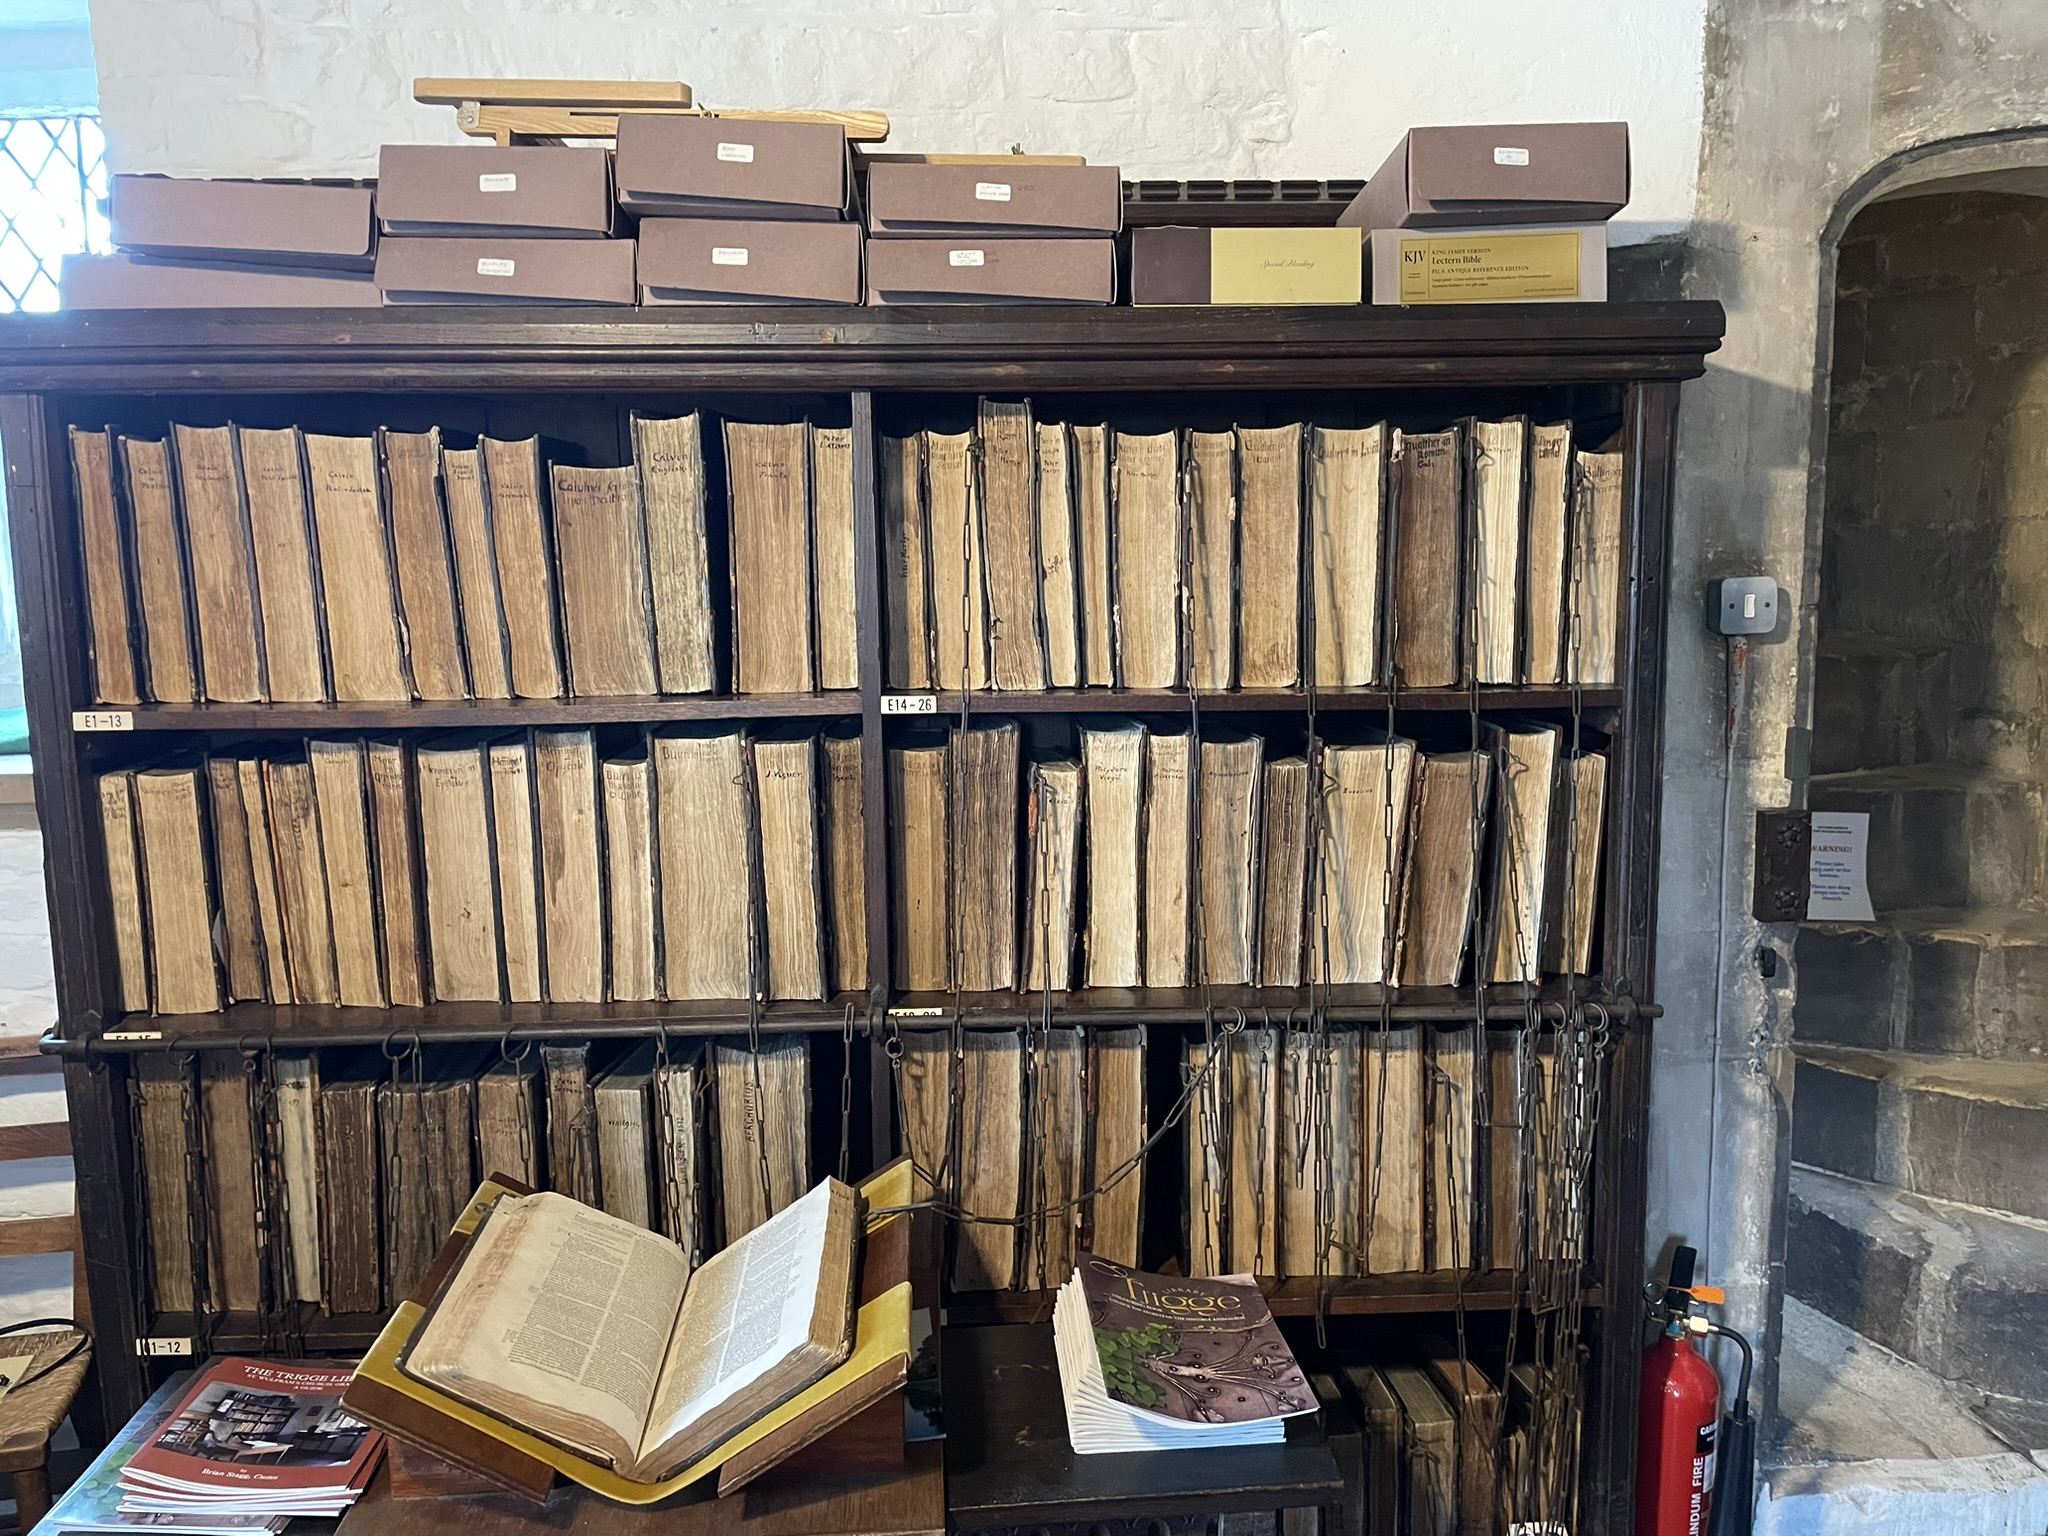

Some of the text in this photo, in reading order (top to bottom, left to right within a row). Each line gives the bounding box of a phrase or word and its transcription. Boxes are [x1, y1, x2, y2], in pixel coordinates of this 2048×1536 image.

[1404, 250, 1426, 264] KJV
[1432, 255, 1482, 265] Lectern Bible
[888, 698, 931, 711] E14-26
[85, 715, 121, 728] E1-13
[1162, 1287, 1208, 1297] LIBRARY
[146, 1341, 181, 1354] 1-12
[244, 1365, 274, 1377] THE
[276, 1371, 329, 1382] TRIGGE
[201, 1468, 225, 1476] Brian
[1689, 1457, 1704, 1536] INDUM FIRE
